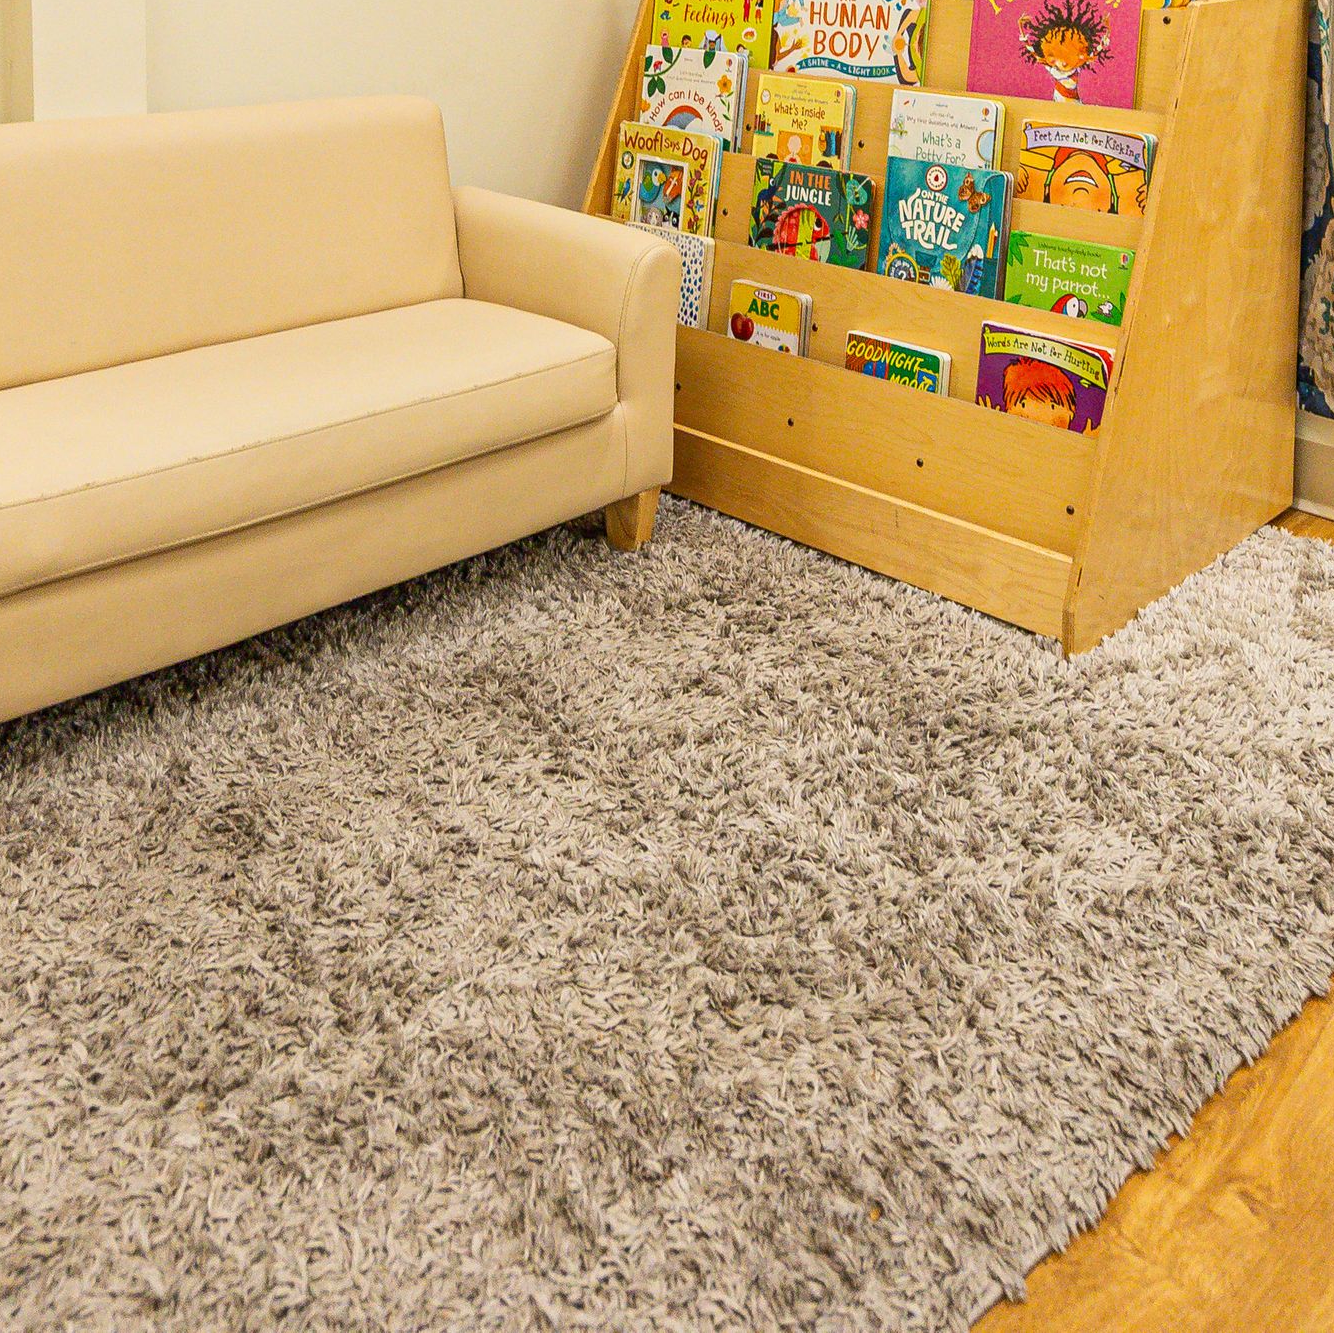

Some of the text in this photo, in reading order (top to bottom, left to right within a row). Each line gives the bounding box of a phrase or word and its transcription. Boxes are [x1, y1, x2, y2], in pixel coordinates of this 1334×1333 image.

[684, 3, 736, 29] Feelings
[809, 1, 891, 31] HUMAN
[813, 29, 880, 61] BODY
[649, 89, 724, 133] How can I be kind?
[774, 101, 826, 120] What's Inside
[791, 118, 808, 131] Me?
[681, 136, 709, 171] Dog
[922, 131, 962, 149] What's a
[1033, 130, 1142, 163] Feet Are Not for Kicking
[915, 146, 967, 166] Potty For?
[789, 170, 832, 190] IN THE
[784, 184, 833, 207] JUNGLE
[921, 190, 949, 205] ON THE
[898, 188, 965, 233] NATURE
[901, 219, 958, 251] TRAIL
[1032, 248, 1108, 279] That's not
[757, 290, 774, 301] FIRST
[1026, 271, 1110, 299] my parrot...
[747, 298, 780, 321] ABC
[846, 340, 924, 373] GOODNIGHT
[987, 336, 1100, 380] Words Are Not for Hurting
